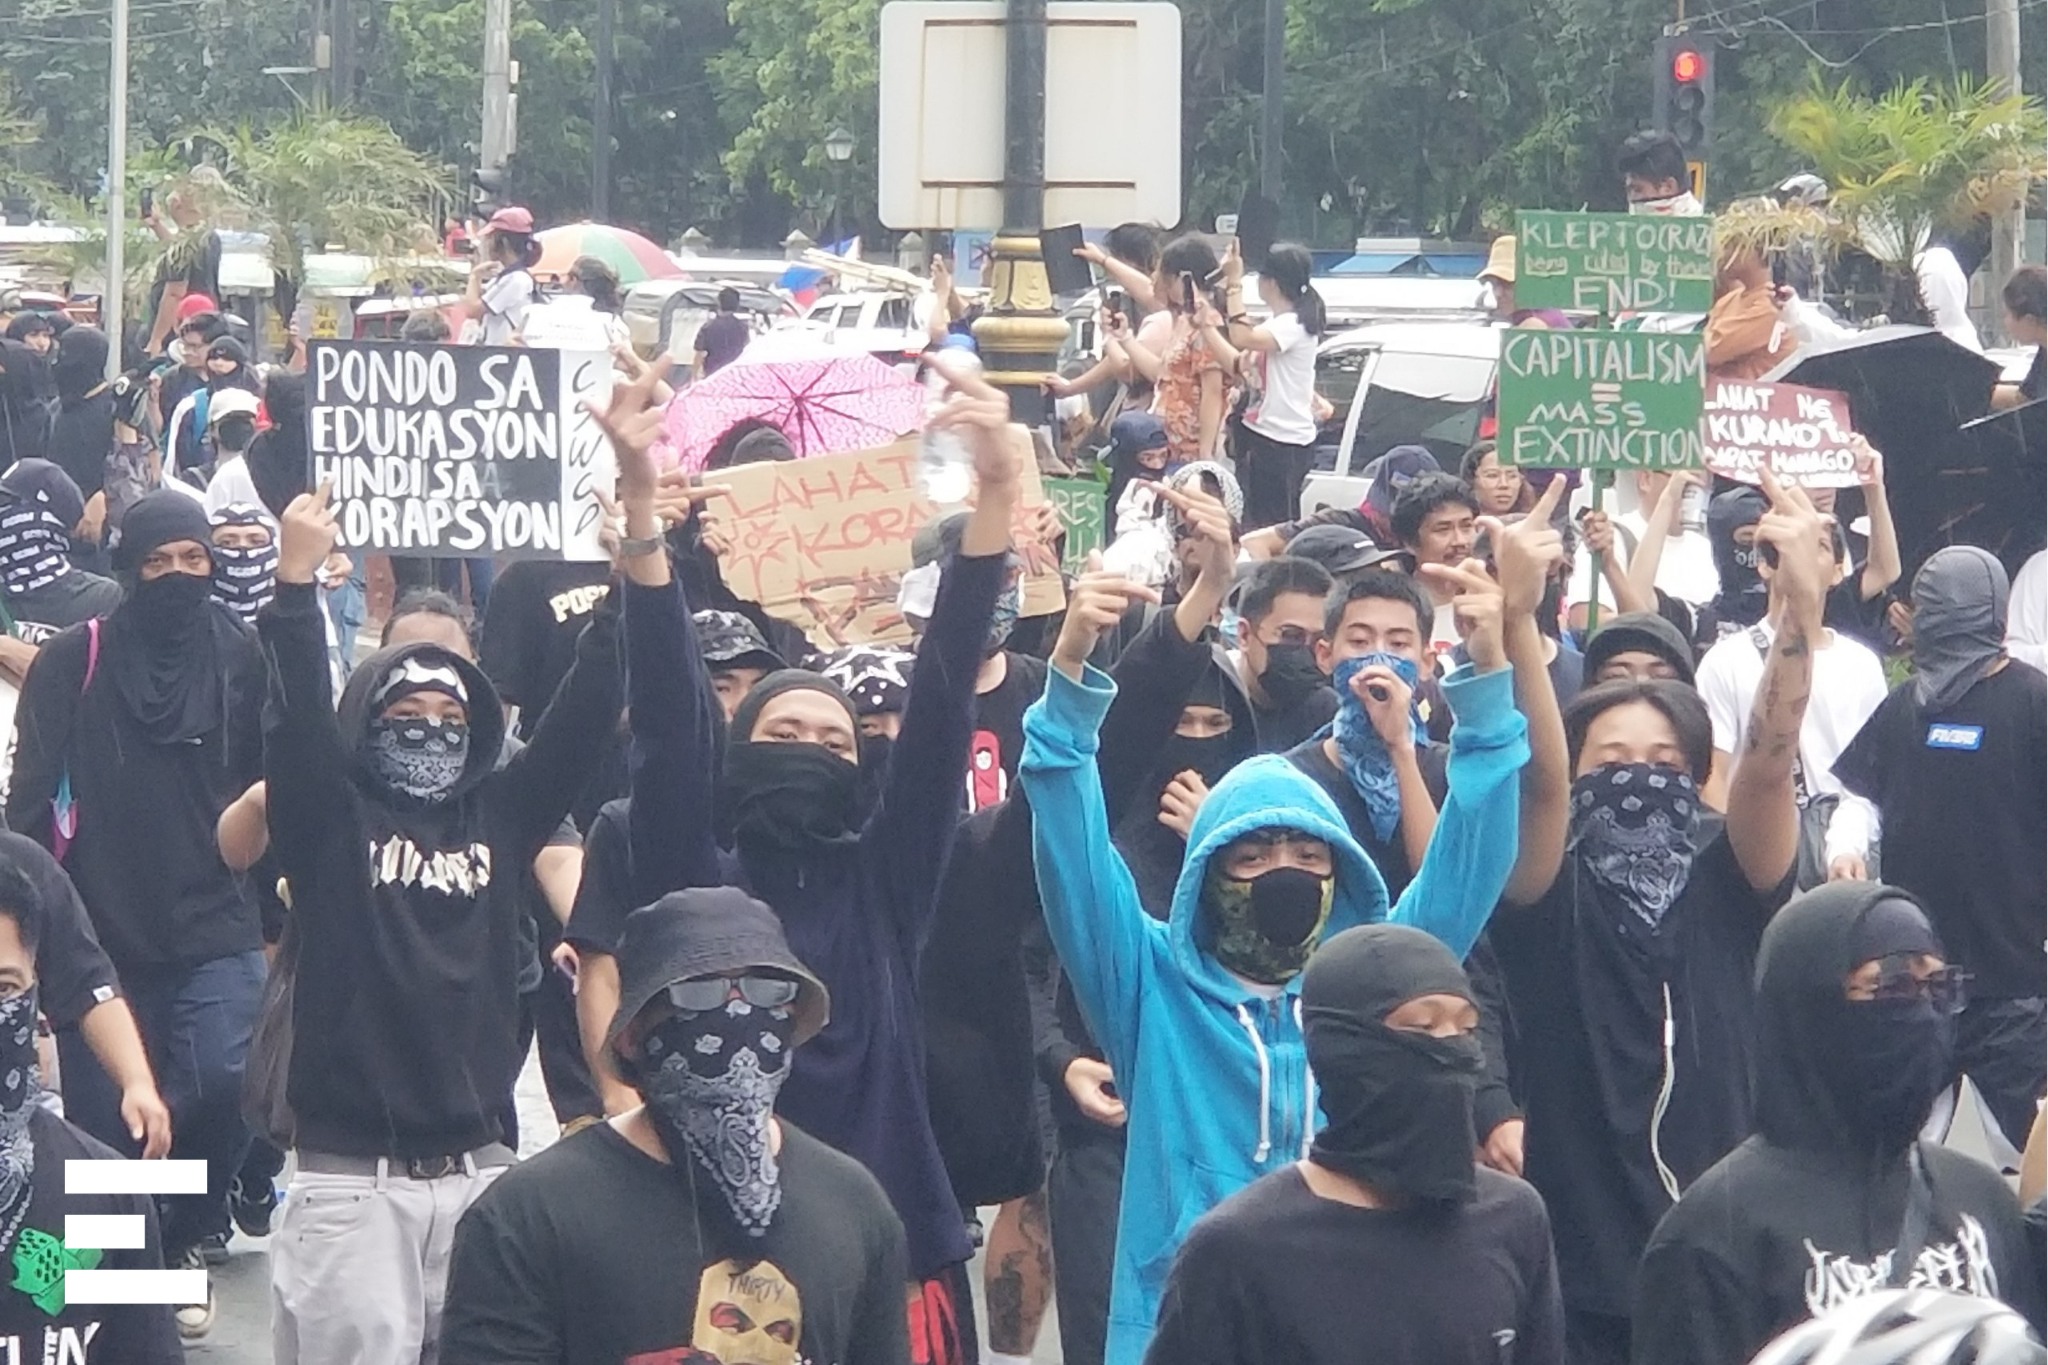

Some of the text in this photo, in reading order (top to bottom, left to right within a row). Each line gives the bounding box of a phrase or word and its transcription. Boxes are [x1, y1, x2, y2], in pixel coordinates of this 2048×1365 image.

[1573, 275, 1675, 314] END!
[316, 347, 544, 410] PONDO SA
[1505, 333, 1705, 388] CAPITALISM
[1527, 401, 1647, 427] MASS
[1704, 383, 1834, 420] AHAT NG
[311, 405, 558, 460] EDUKASYON
[1513, 417, 1706, 467] EXTINCTION
[315, 455, 423, 500] HINDI
[726, 455, 920, 520] LAHAT
